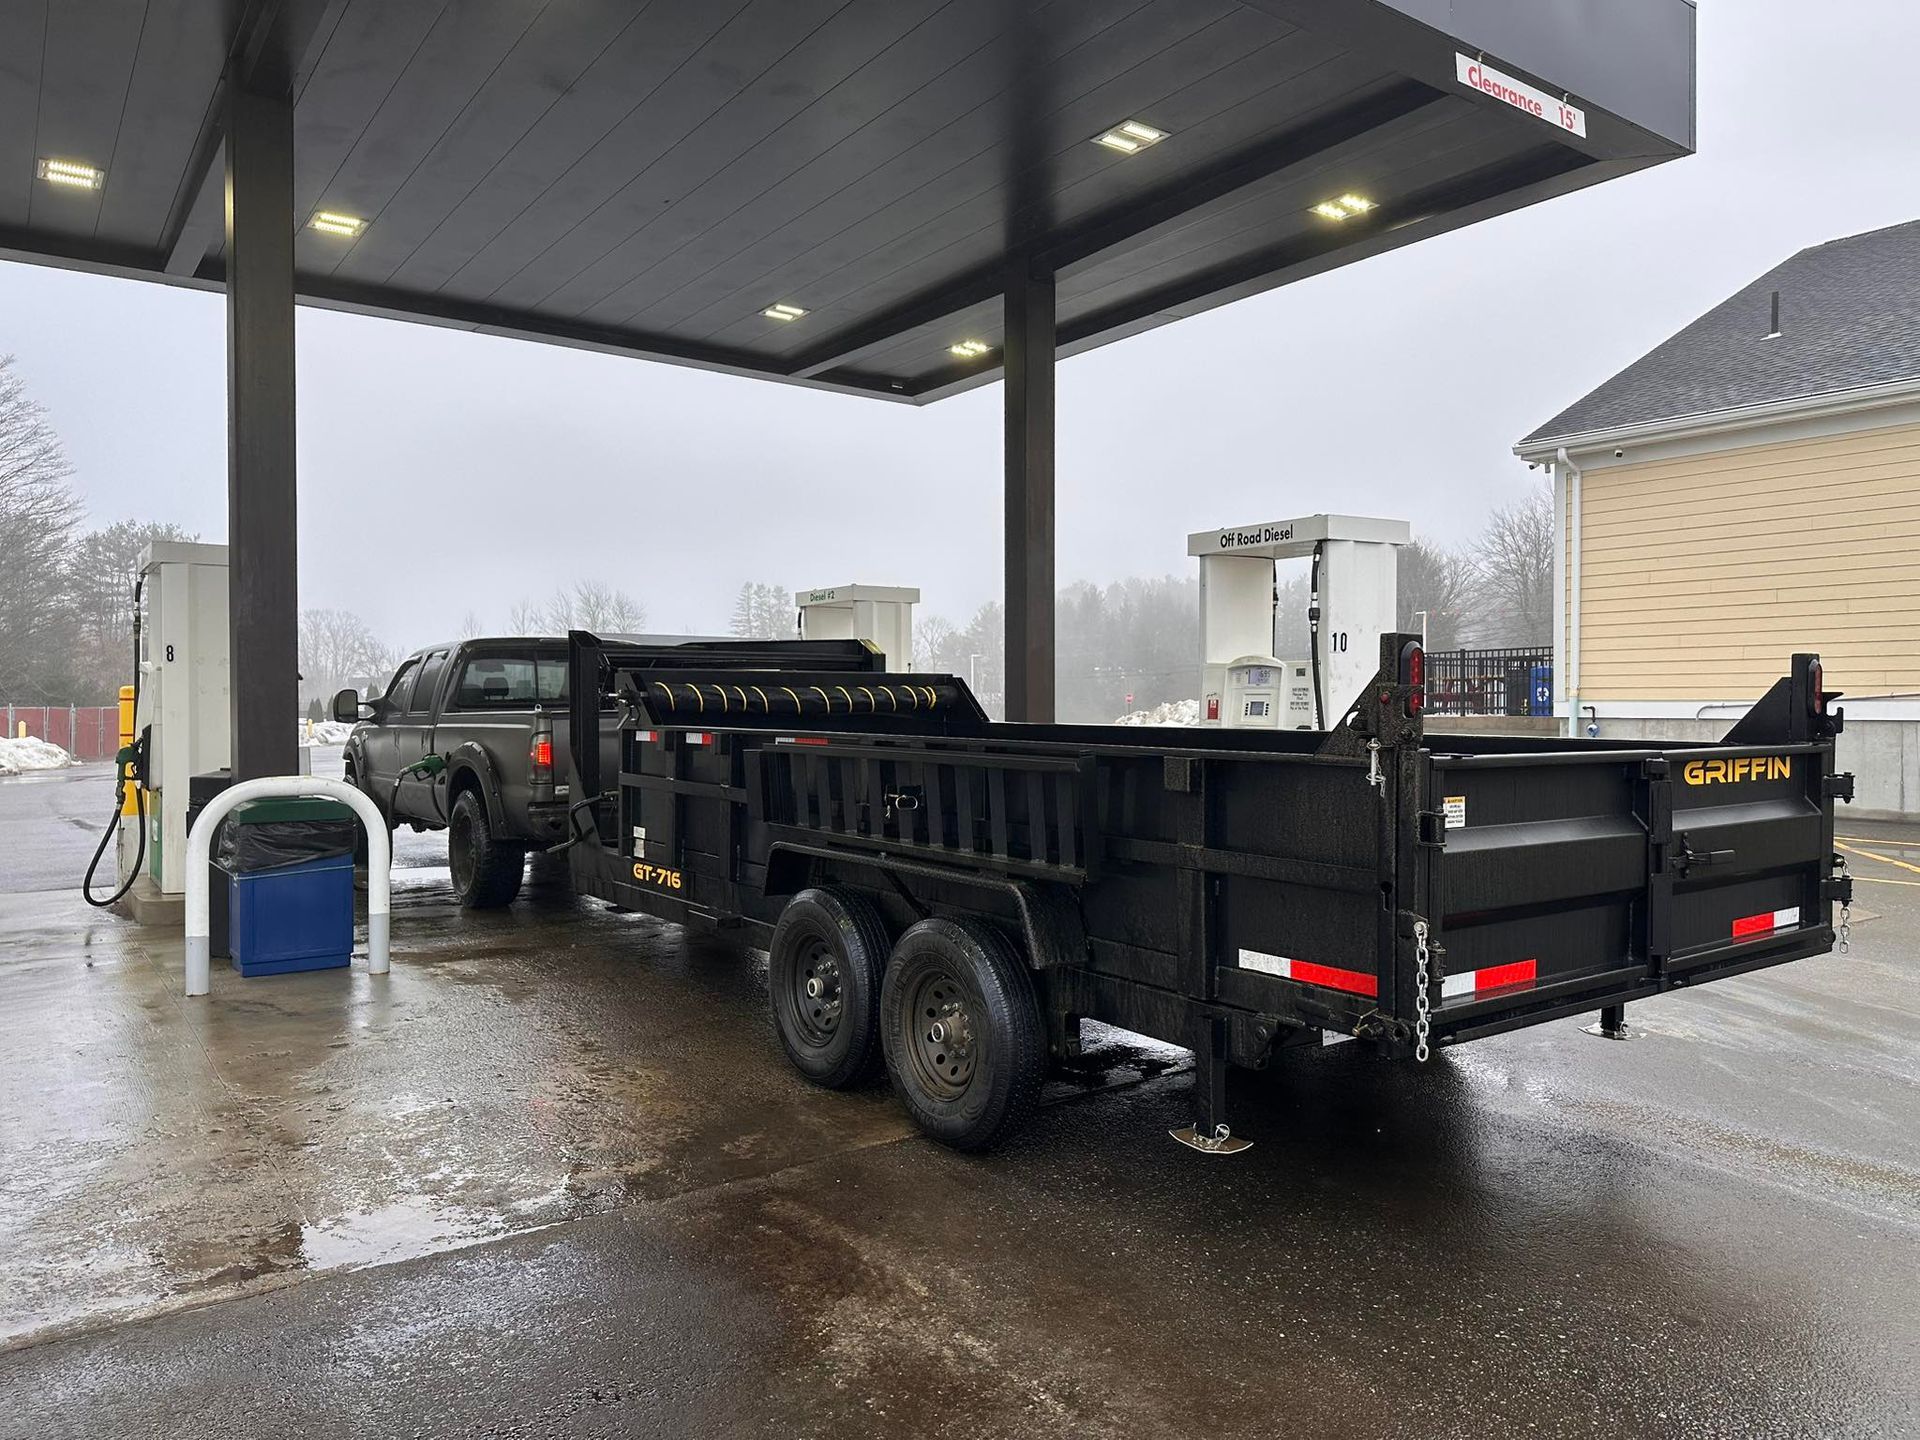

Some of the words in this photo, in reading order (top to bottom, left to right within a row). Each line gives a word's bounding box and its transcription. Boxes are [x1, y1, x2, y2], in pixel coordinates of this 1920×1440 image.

[1468, 65, 1543, 116] Clearance
[1559, 106, 1576, 130] 15'
[1220, 532, 1235, 548] Off
[1237, 528, 1262, 545] Road
[1265, 524, 1293, 542] Diesel
[810, 591, 826, 602] Diesel
[166, 644, 175, 662] 8
[1331, 632, 1348, 652] 10
[1684, 756, 1791, 785] GRIFFIN
[633, 862, 682, 889] GT-716
